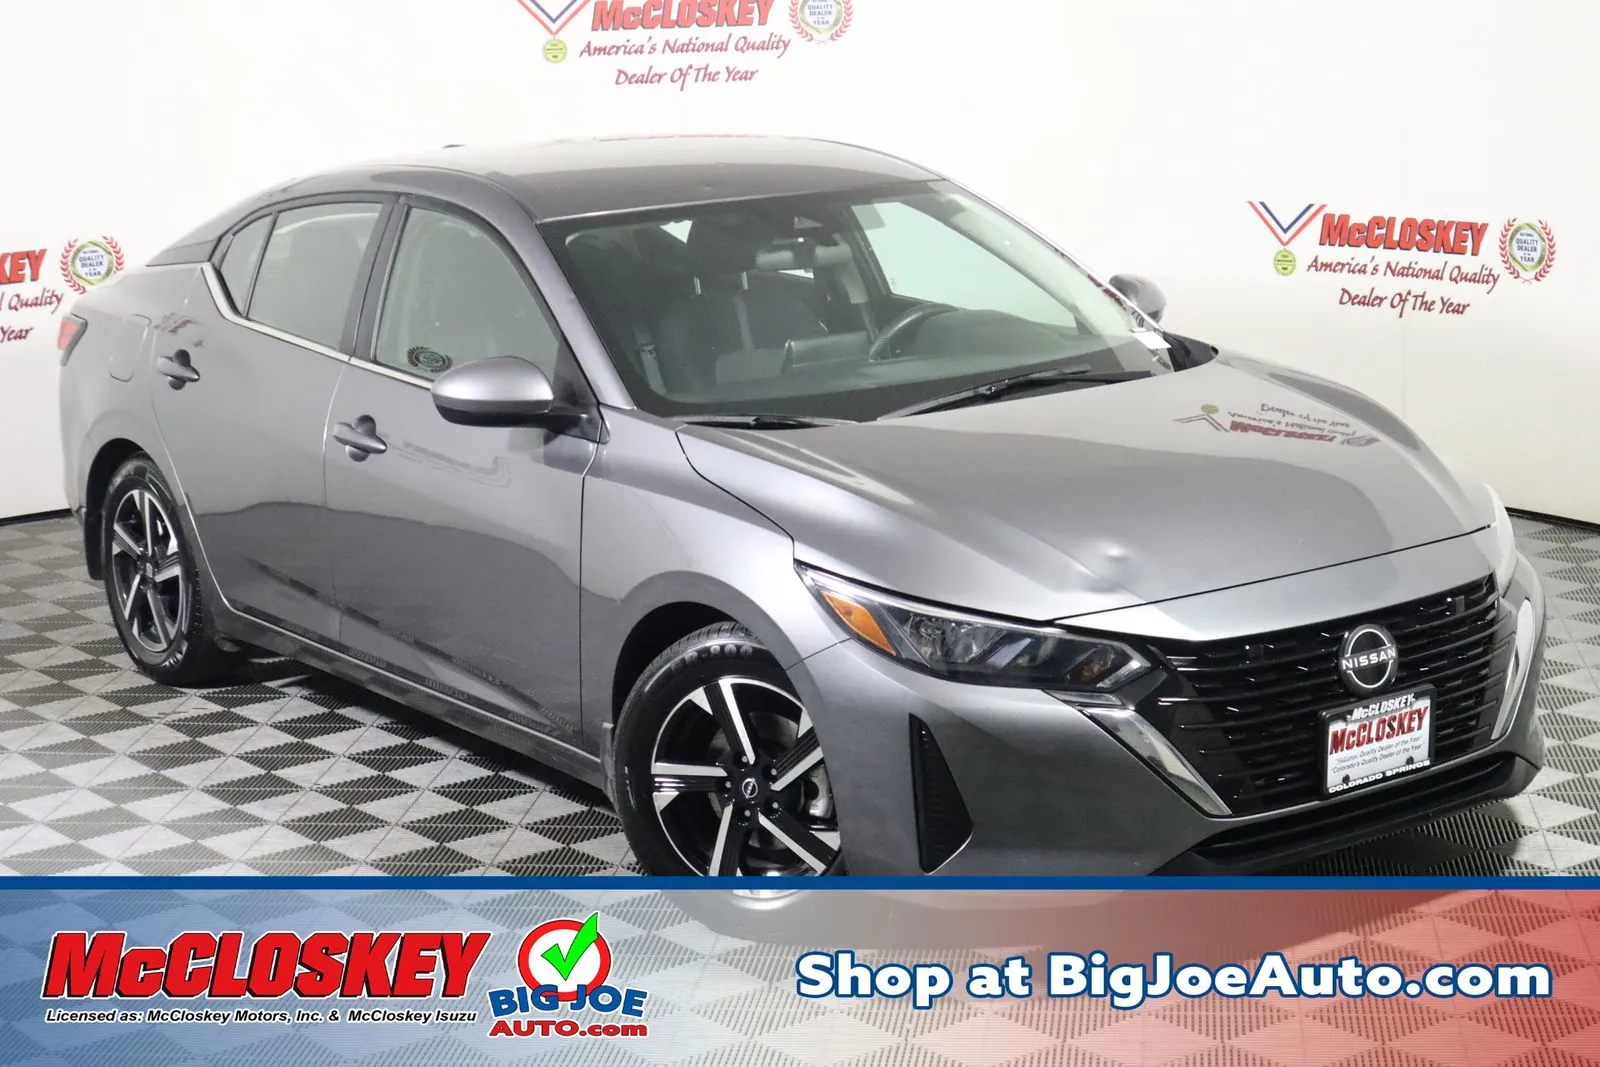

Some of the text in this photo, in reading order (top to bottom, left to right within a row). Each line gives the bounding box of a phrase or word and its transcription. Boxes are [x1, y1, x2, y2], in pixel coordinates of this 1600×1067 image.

[591, 0, 775, 31] McCLOSKEY
[579, 35, 657, 58] America's
[662, 33, 729, 55] National
[734, 32, 791, 60] Quality
[615, 64, 759, 91] Dealer Of The Year
[1319, 212, 1489, 256] McCLOSKEY
[1307, 254, 1379, 276] America's
[1383, 260, 1444, 281] National
[1449, 265, 1501, 295] Quality
[8, 287, 64, 315] Quality
[1339, 287, 1470, 318] Dealer Of The Year
[0, 326, 34, 343] Year
[1342, 647, 1396, 670] NISSAN
[1352, 693, 1414, 721] McCLOSKEY
[1330, 706, 1429, 755] McCLOSKEY
[1328, 760, 1431, 793] COLORADO SPRINGS
